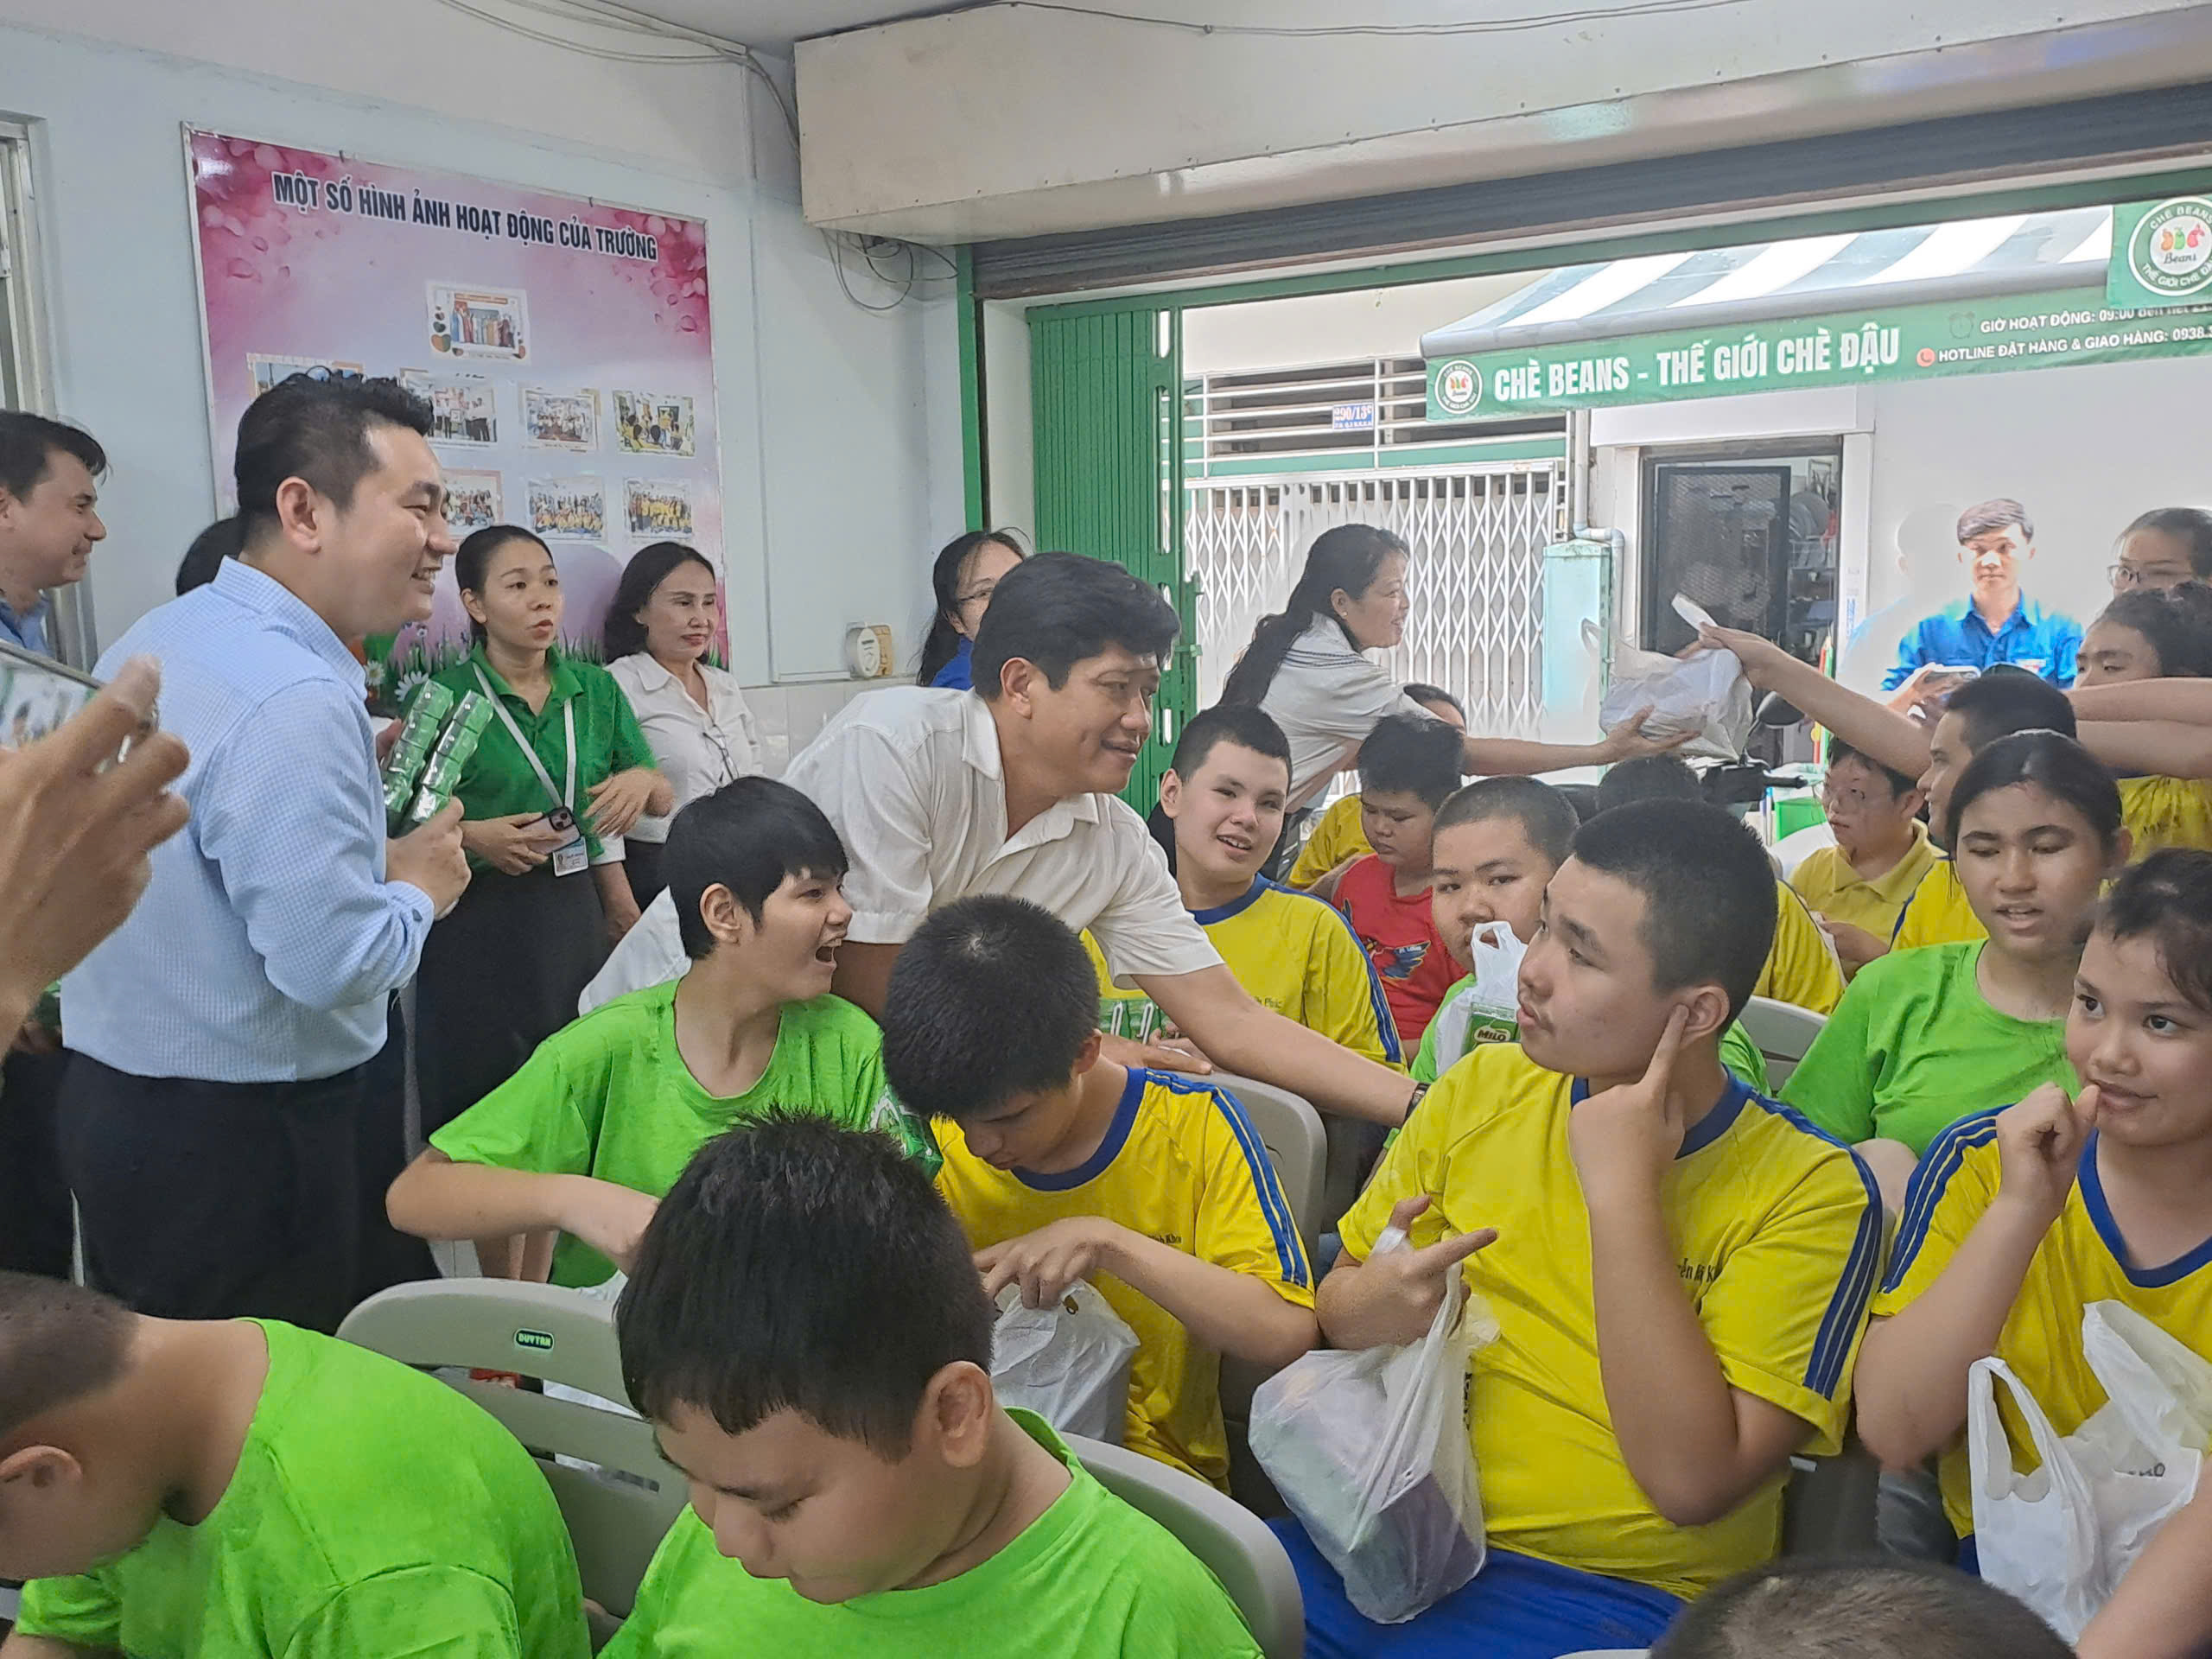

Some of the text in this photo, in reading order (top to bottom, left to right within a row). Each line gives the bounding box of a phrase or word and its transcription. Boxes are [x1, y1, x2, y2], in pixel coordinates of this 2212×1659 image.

[273, 171, 658, 260] MỘT SỐ HÌNH ẢNH HOẠT ĐỘNG CỦA TRƯỜNG
[1980, 317, 2007, 334] GIỜ
[2009, 315, 2048, 332] HOẠT
[2050, 310, 2096, 328] ĐỘNG:
[1494, 357, 1541, 402] CHÈ
[1548, 356, 1630, 397] BEANS
[1656, 338, 1708, 386] THẾ
[1713, 333, 1768, 381] GIỚI
[1777, 327, 1831, 375] CHÈ
[1840, 321, 1900, 374] ĐẬU
[1938, 346, 1995, 363] HOTLINE
[2029, 338, 2068, 354] HÀNG
[2071, 338, 2082, 351] &
[2084, 334, 2120, 349] GIAO
[2122, 329, 2170, 346] HÀNG:
[1478, 1029, 1507, 1042] MILO
